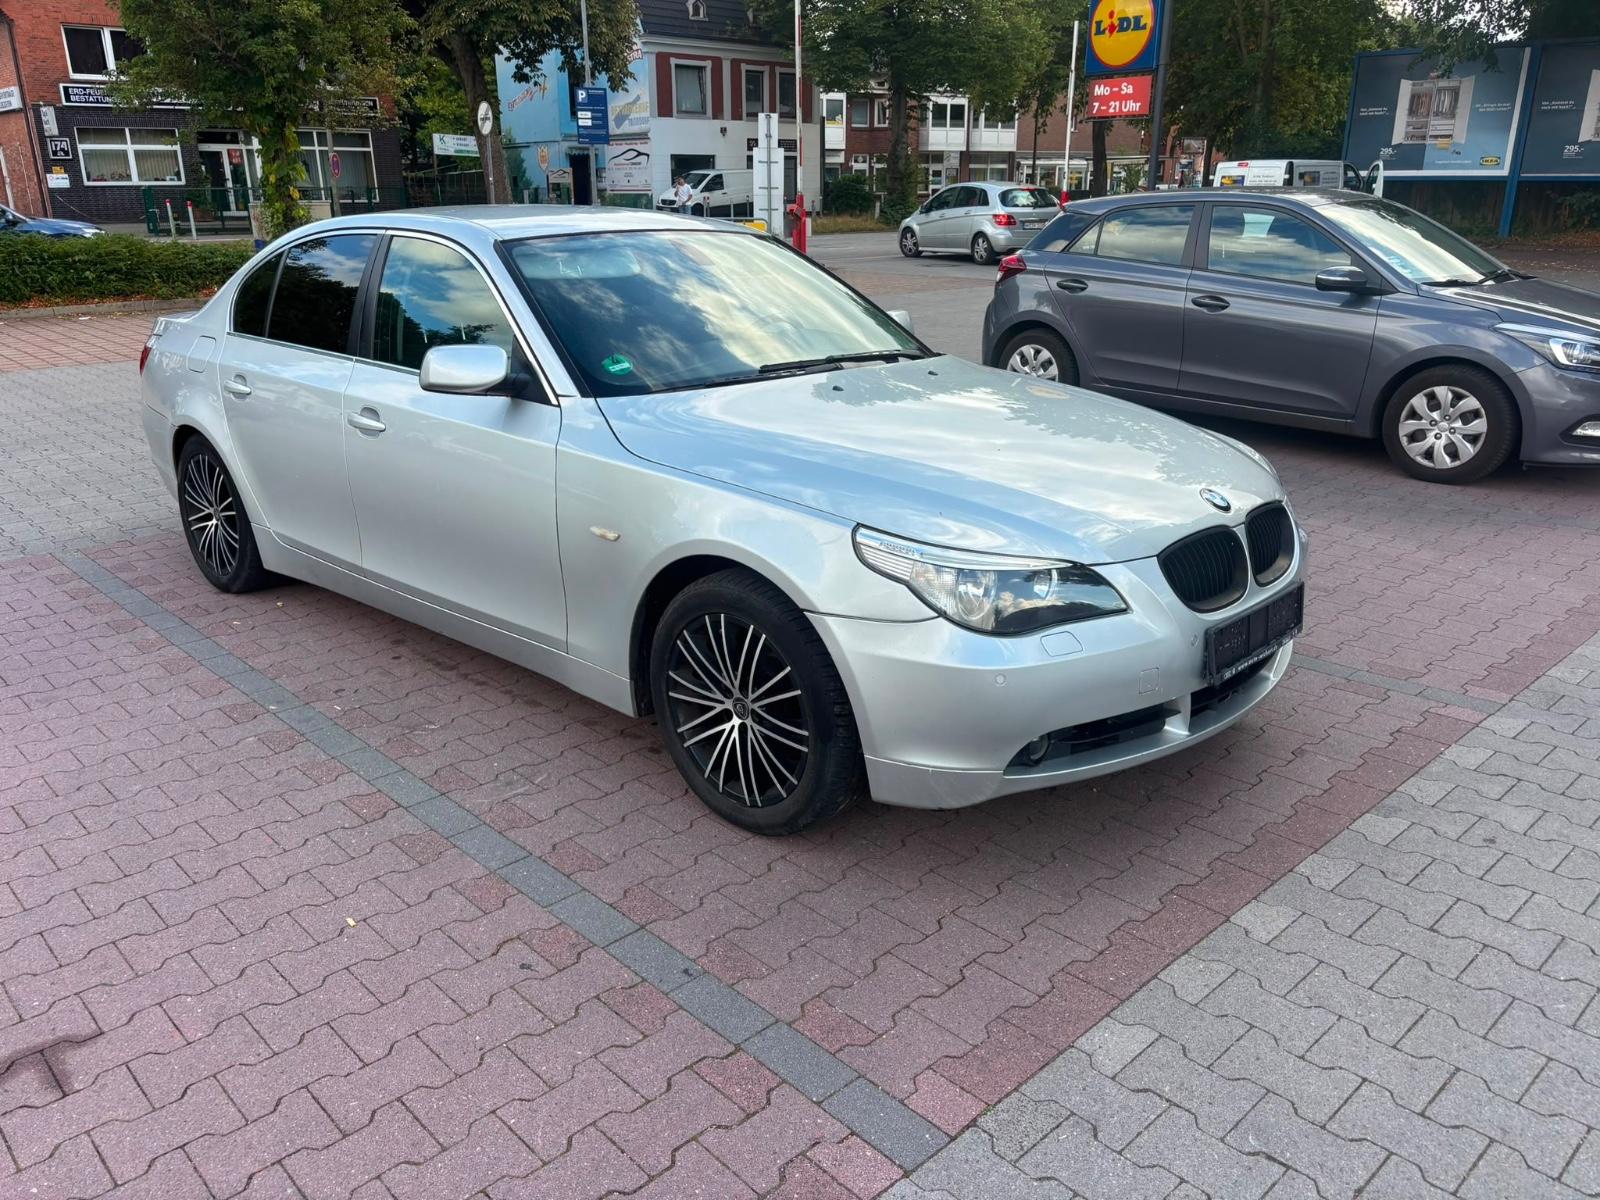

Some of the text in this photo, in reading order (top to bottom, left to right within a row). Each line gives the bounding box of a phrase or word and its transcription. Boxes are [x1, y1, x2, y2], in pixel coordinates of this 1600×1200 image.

[1094, 84, 1110, 96] Mo
[1121, 82, 1133, 94] Sa
[578, 90, 586, 103] P
[1092, 102, 1099, 114] 7
[1108, 102, 1120, 113] 21
[1122, 100, 1141, 112] Uhr
[51, 141, 68, 151] 174
